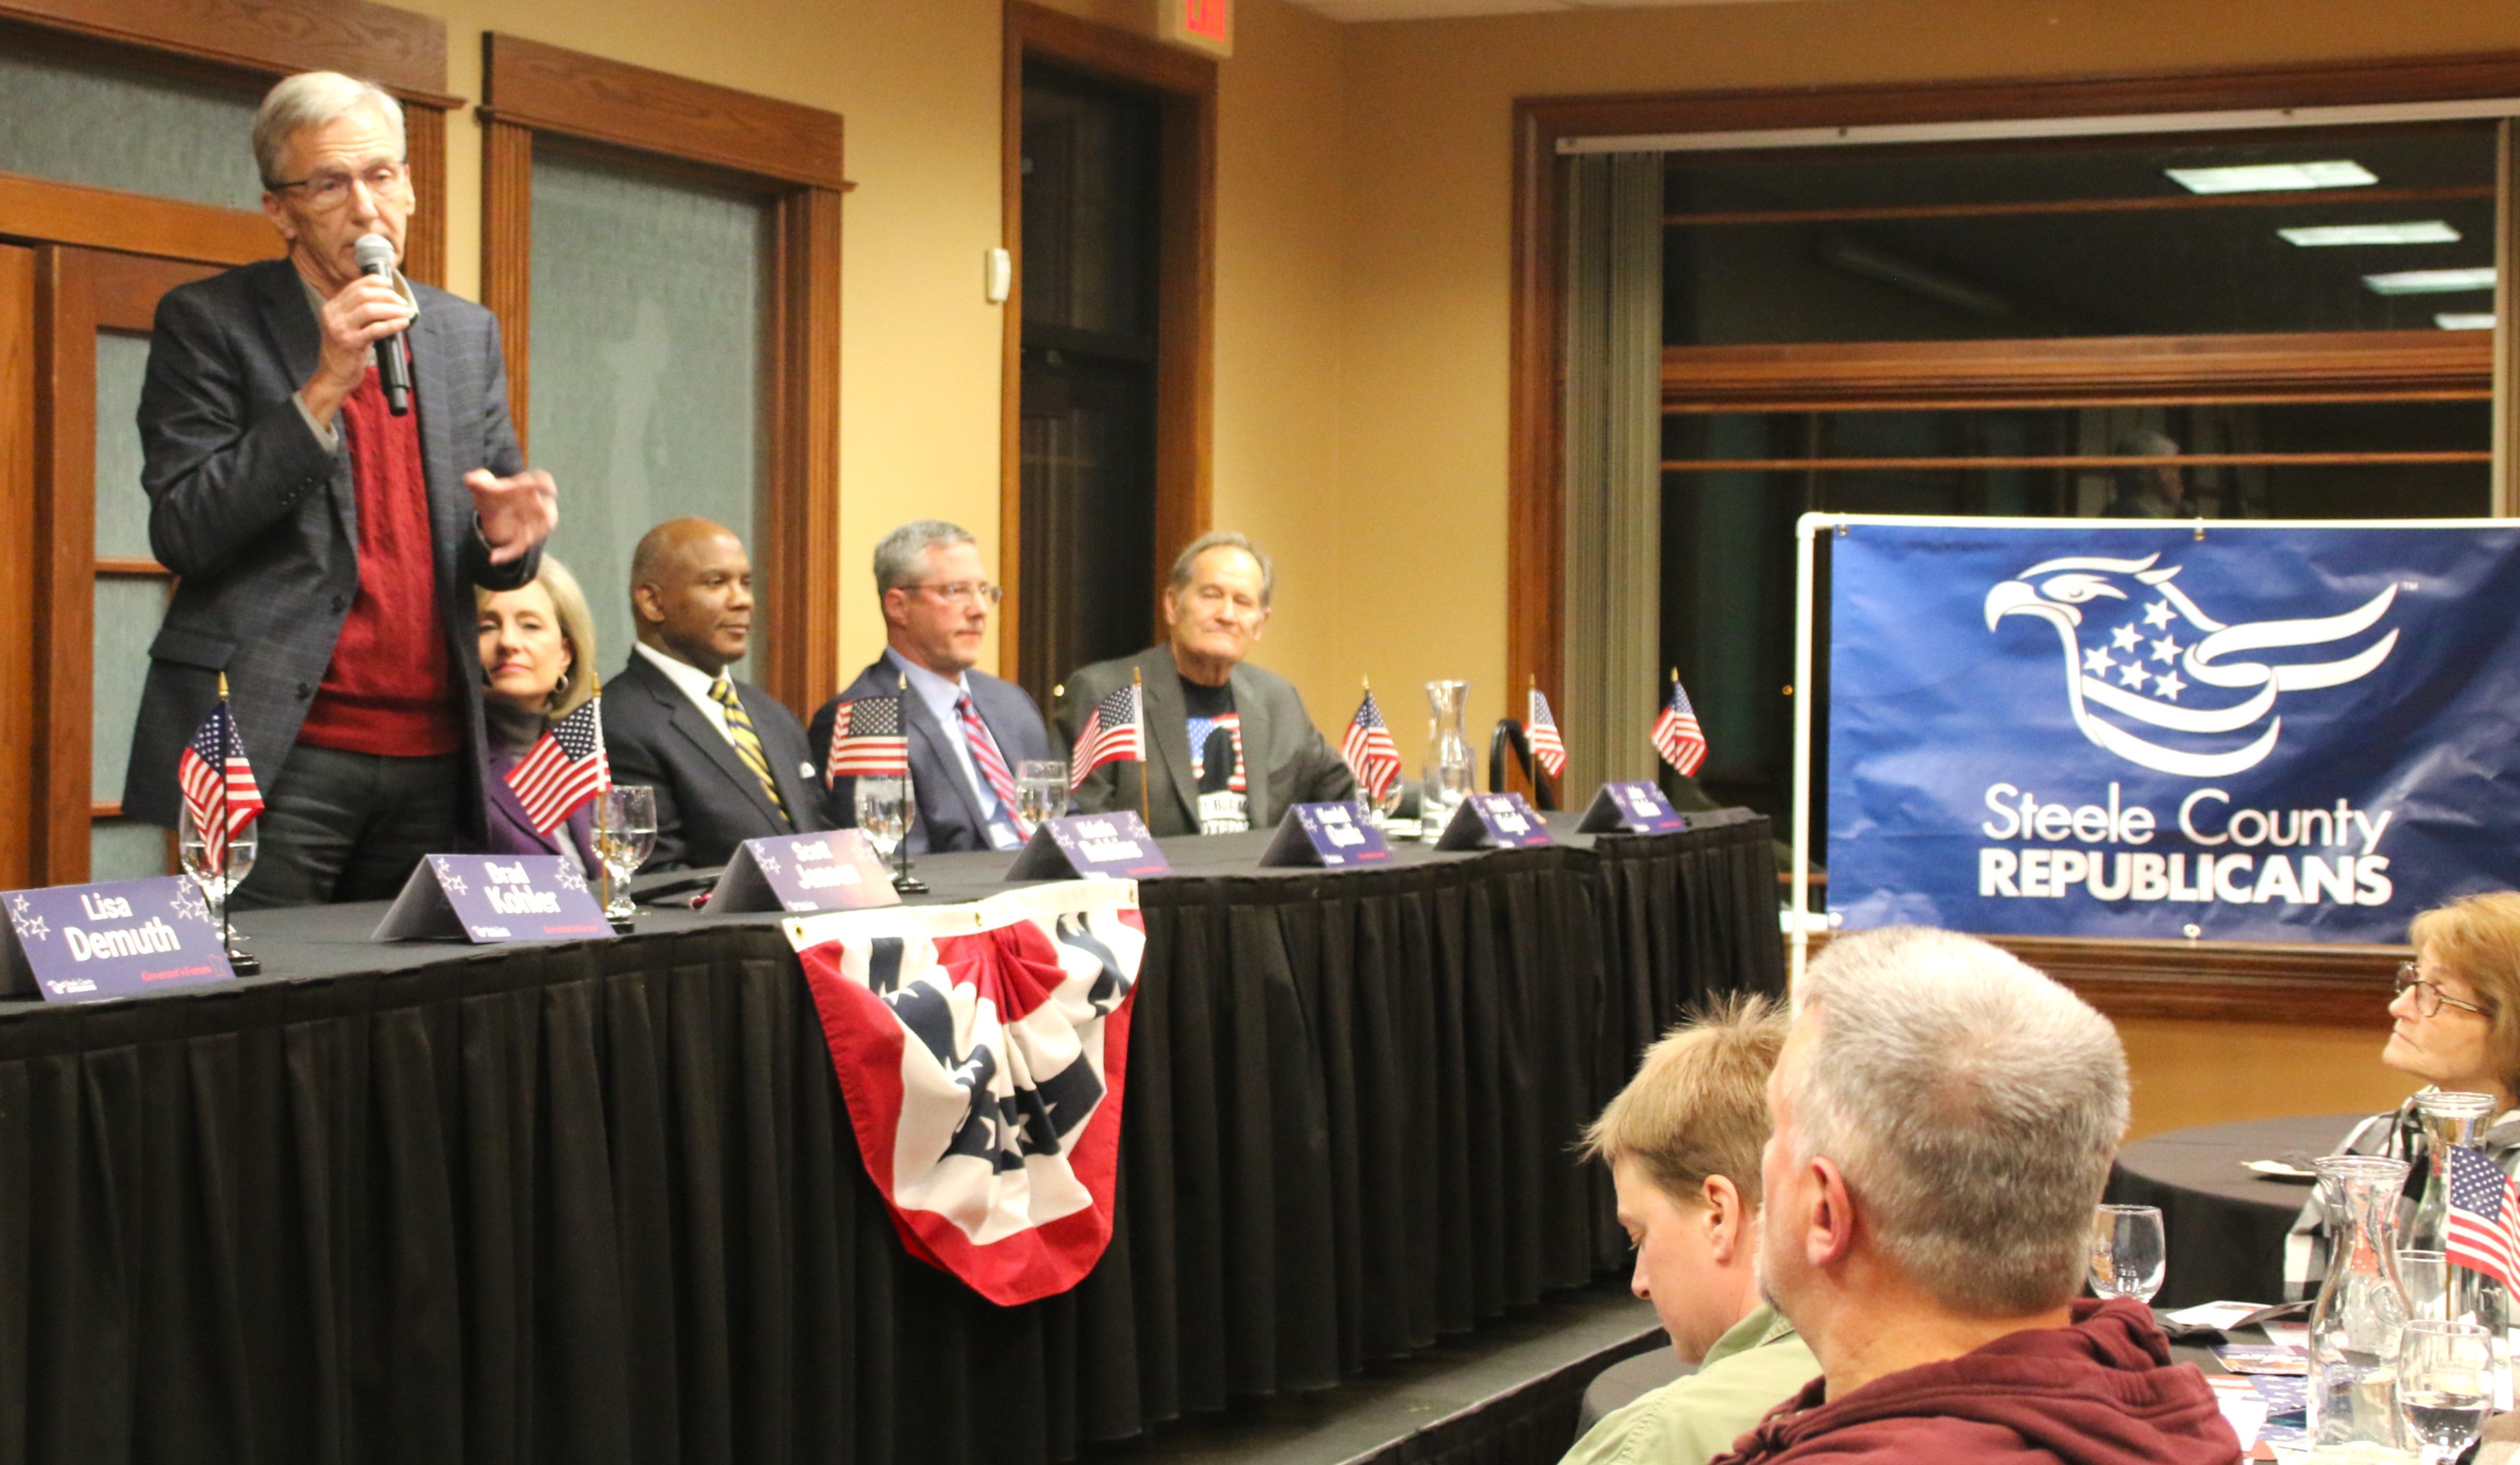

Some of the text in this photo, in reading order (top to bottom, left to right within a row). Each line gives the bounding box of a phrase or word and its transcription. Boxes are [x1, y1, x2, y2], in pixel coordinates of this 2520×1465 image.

[1982, 782, 2393, 855] Steele County
[484, 861, 531, 884] Brad
[1979, 848, 2393, 906] REPUBLICANS
[81, 893, 133, 921] Lisa
[484, 885, 562, 914] Kohler
[64, 916, 181, 962] Demuth
